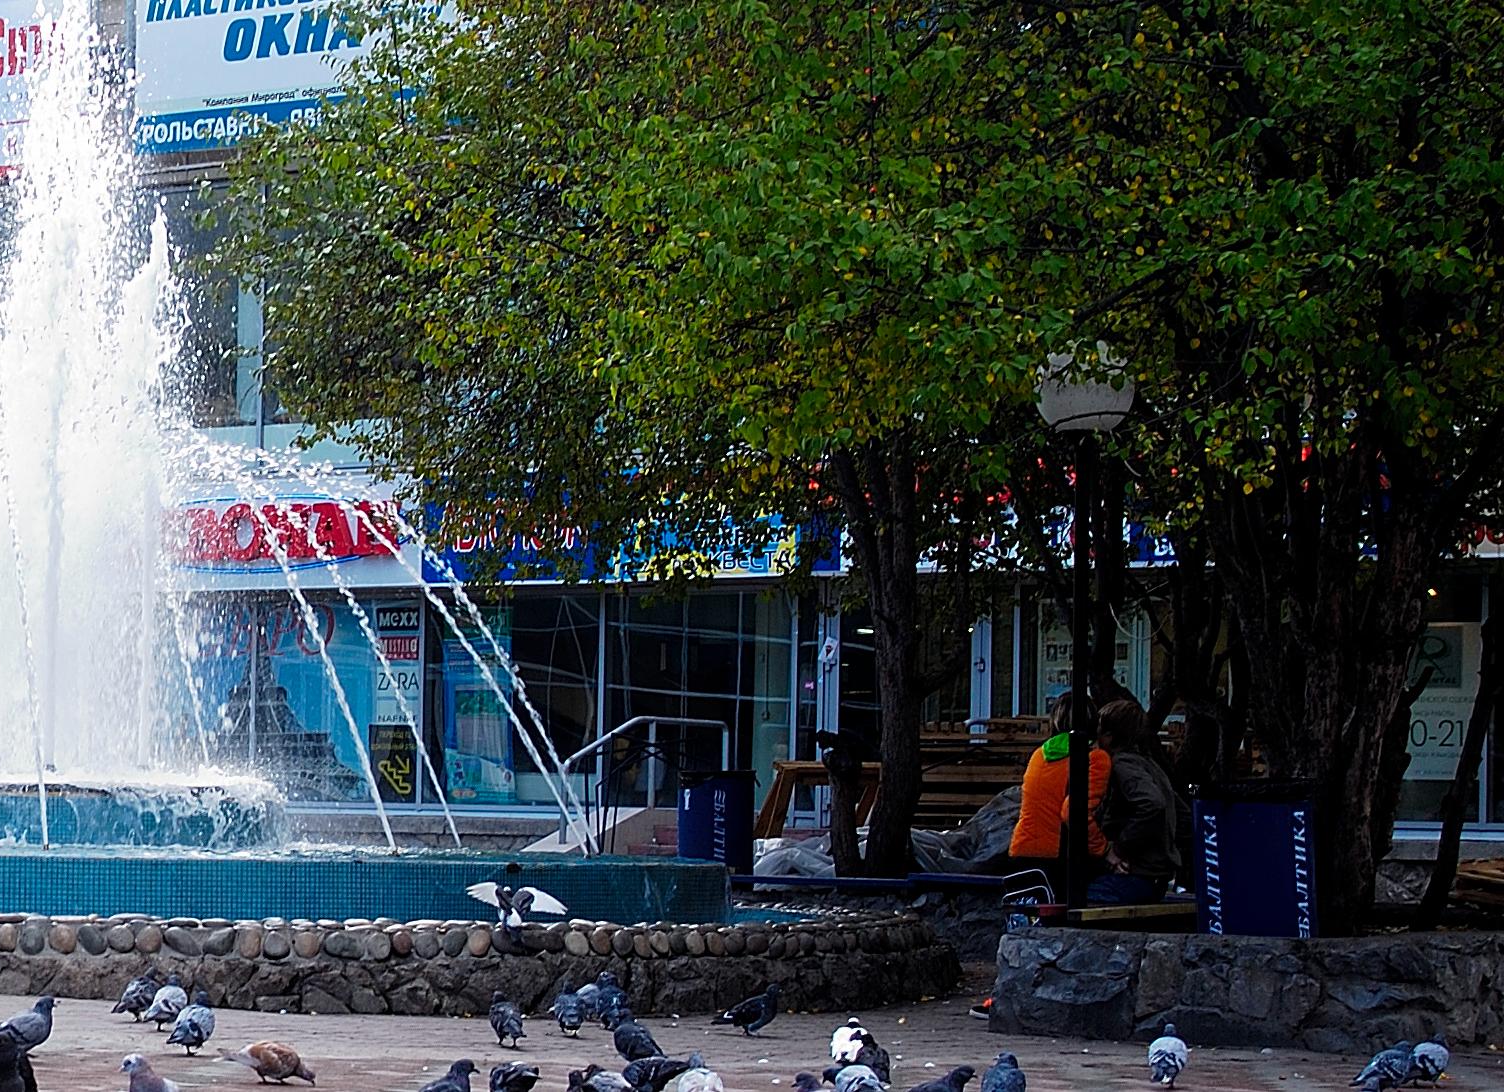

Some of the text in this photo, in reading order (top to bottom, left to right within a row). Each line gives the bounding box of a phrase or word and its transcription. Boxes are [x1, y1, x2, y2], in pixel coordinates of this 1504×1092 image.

[223, 9, 362, 62] ОКНА
[1410, 719, 1464, 747] 0-21
[713, 803, 726, 860] БАЛТИ
[1203, 813, 1224, 936] БАЛТИКА
[1292, 810, 1310, 934] БАЛТИКА
